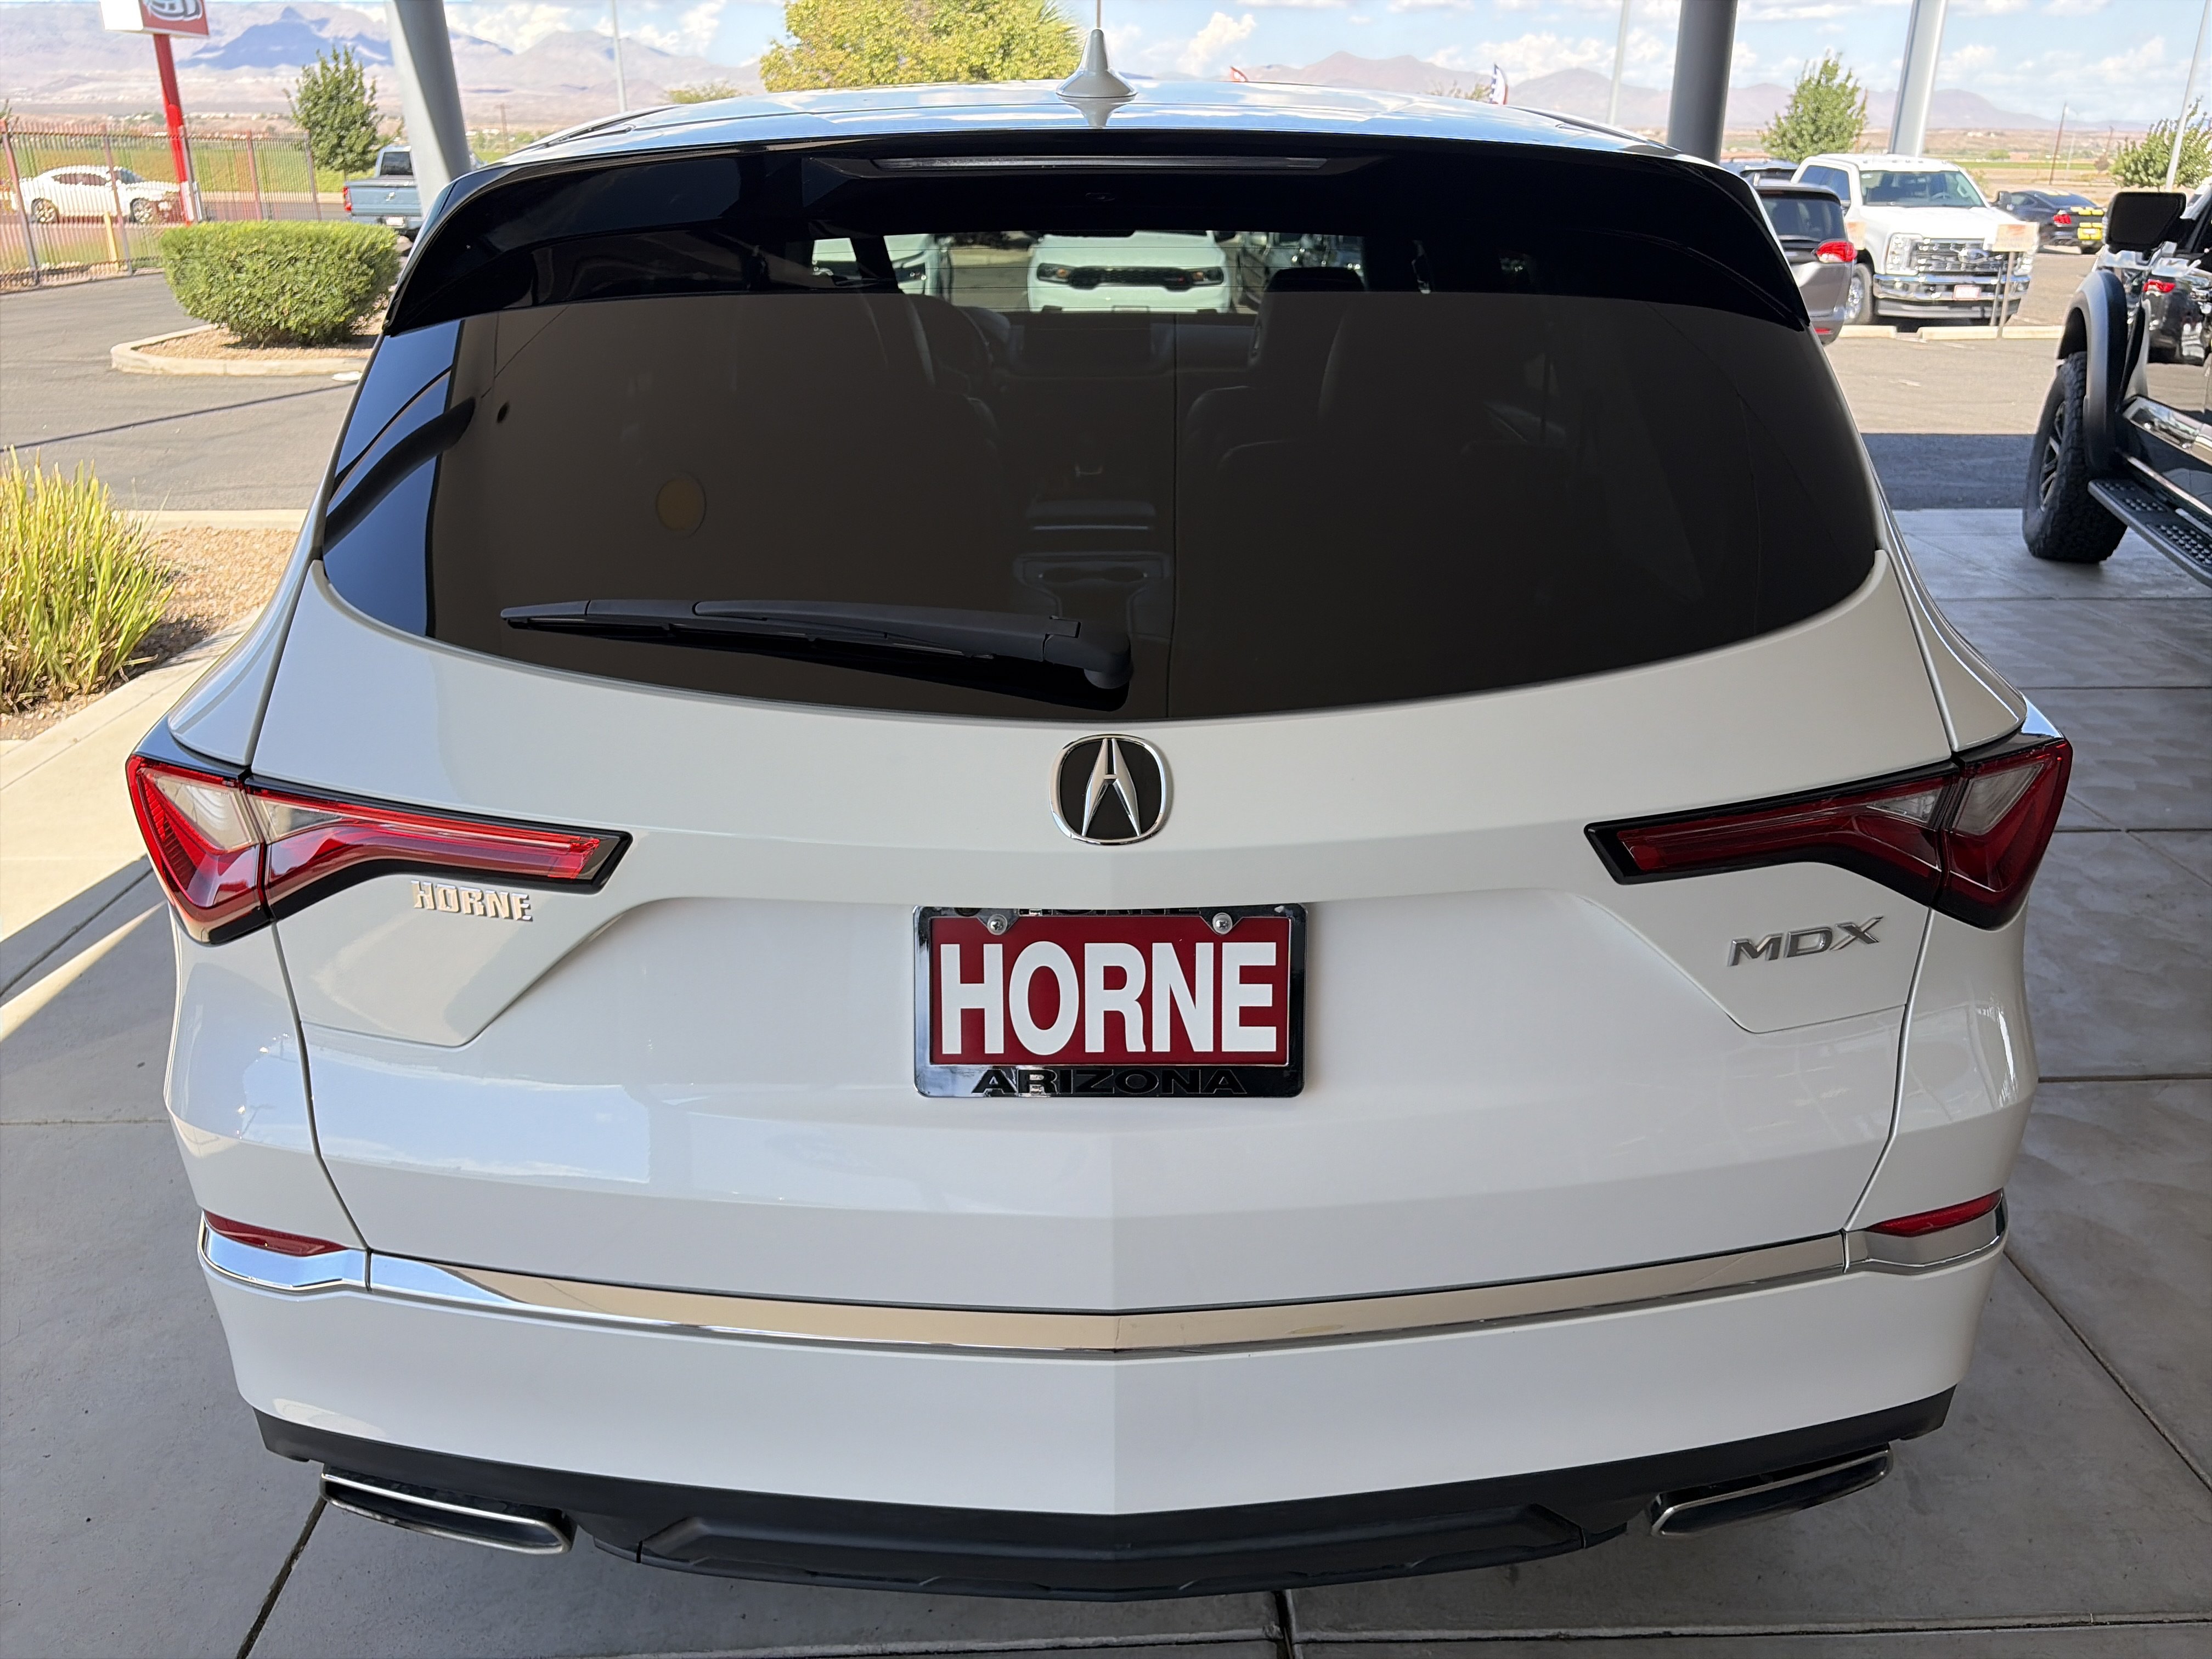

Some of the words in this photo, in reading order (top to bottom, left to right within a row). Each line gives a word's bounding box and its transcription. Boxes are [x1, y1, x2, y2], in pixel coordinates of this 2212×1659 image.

[411, 880, 533, 922] HORNE
[1728, 915, 1884, 967] MDX
[940, 940, 1277, 1056] HORNE
[970, 1068, 1248, 1094] ARIZONA
